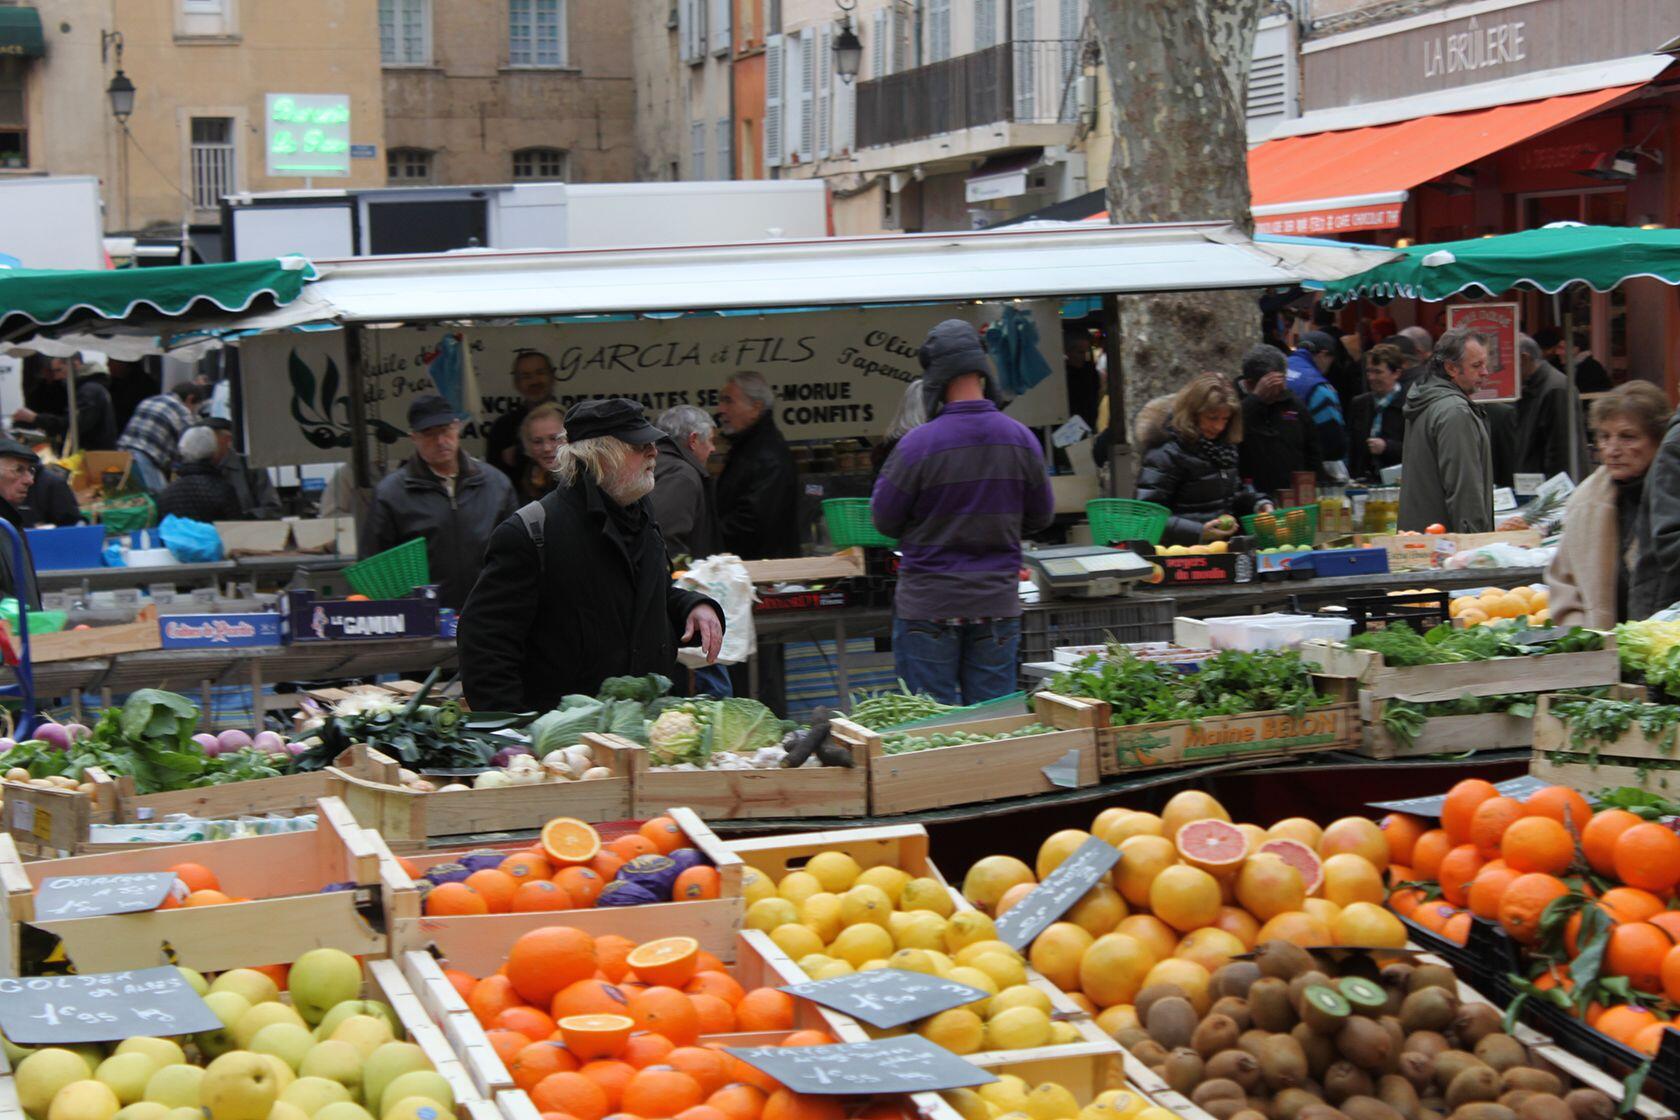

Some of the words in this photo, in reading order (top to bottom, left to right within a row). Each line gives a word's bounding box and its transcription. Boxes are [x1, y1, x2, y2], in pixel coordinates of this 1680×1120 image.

[1423, 38, 1446, 78] LA
[1446, 16, 1526, 73] BRÛLERIE
[553, 342, 700, 382] GARCIA
[734, 336, 816, 366] FILS
[864, 329, 922, 359] Oliv
[782, 403, 874, 425] CONFITS
[330, 615, 343, 626] LE
[343, 614, 406, 636] GAMIN
[1184, 722, 1257, 748] Maine
[1260, 711, 1339, 741] BELON
